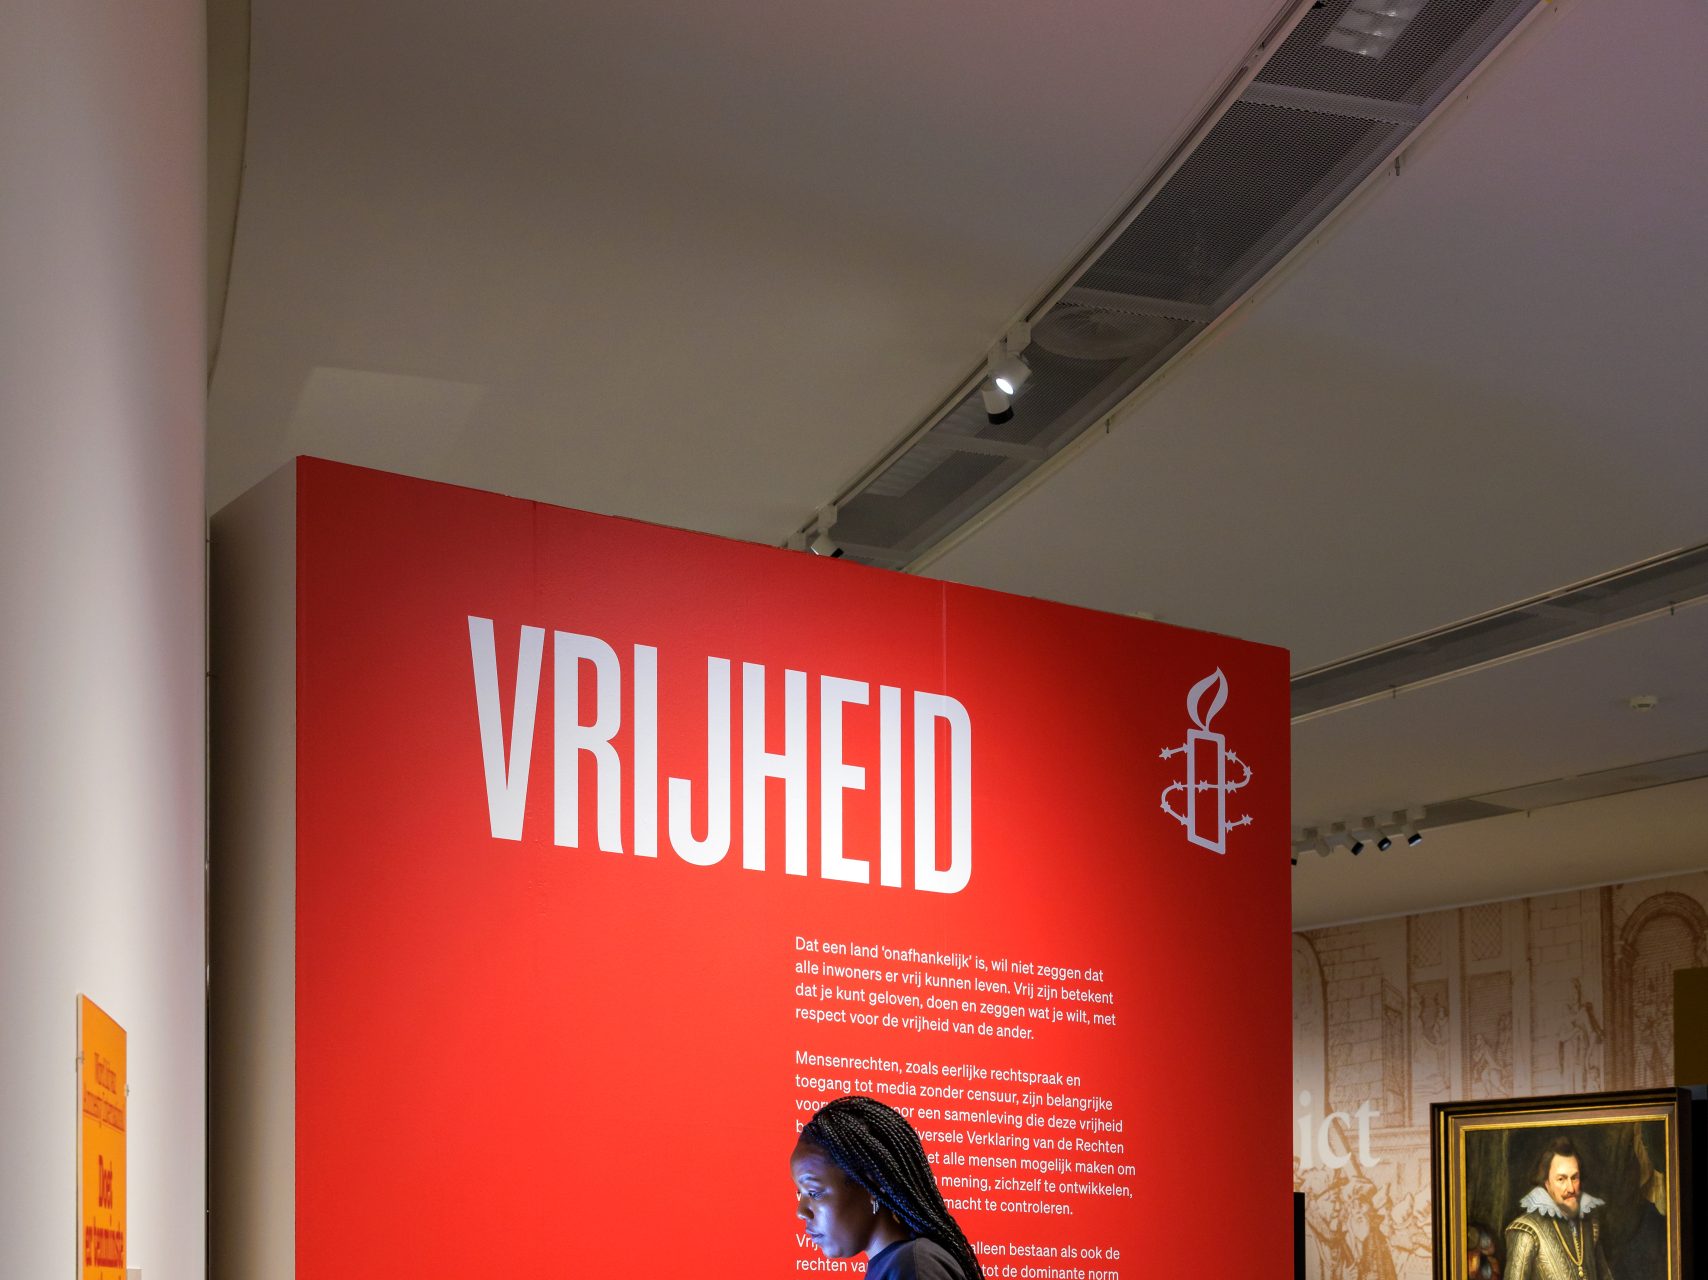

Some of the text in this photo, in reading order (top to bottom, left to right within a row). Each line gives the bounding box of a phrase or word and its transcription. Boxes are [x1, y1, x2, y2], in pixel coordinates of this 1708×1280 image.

[467, 615, 972, 894] VRIJHEID
[795, 935, 819, 953] Dat
[822, 942, 847, 955] een
[850, 942, 879, 959] land
[975, 955, 988, 972] is,
[991, 958, 1008, 972] wil
[1011, 960, 1034, 975] niet
[1037, 964, 1081, 981] zeggen
[1084, 968, 1103, 982] dat
[795, 959, 1113, 1004] alle inwoners er vrij kunnen leven. Vrij zijn betekent
[795, 982, 1116, 1026] dat je kunt geloven, doen en zeggen wat je wilt, met
[795, 1008, 1034, 1040] respect voor de vrijheid van de ander.
[795, 1050, 1081, 1086] Mensenrechten, zoals eerlijke rechtspraak en
[795, 1074, 1113, 1112] toegang tot media zonder censuur, zijn belangrijke
[795, 1099, 1123, 1134] voor oor een samenleving die deze vrijheid
[1297, 1089, 1381, 1169] ict
[966, 1130, 1030, 1151] Verklaring
[1033, 1138, 1054, 1149] van
[1057, 1137, 1073, 1150] de
[1076, 1138, 1124, 1154] Rechten
[927, 1151, 1136, 1175] et alle mensen mogelijk maken om
[941, 1174, 991, 1192] mening,
[994, 1177, 1041, 1191] zichzelf
[1043, 1180, 1056, 1192] te
[1059, 1181, 1132, 1198] ontwikkelen,
[943, 1197, 1073, 1215] macht te controleren.
[970, 1241, 1006, 1255] alleen
[1009, 1242, 1057, 1257] bestaan
[1061, 1244, 1078, 1258] als
[1080, 1245, 1102, 1259] ook
[1105, 1247, 1120, 1260] de
[796, 1257, 1119, 1280] rechten va tot de dominante norm
